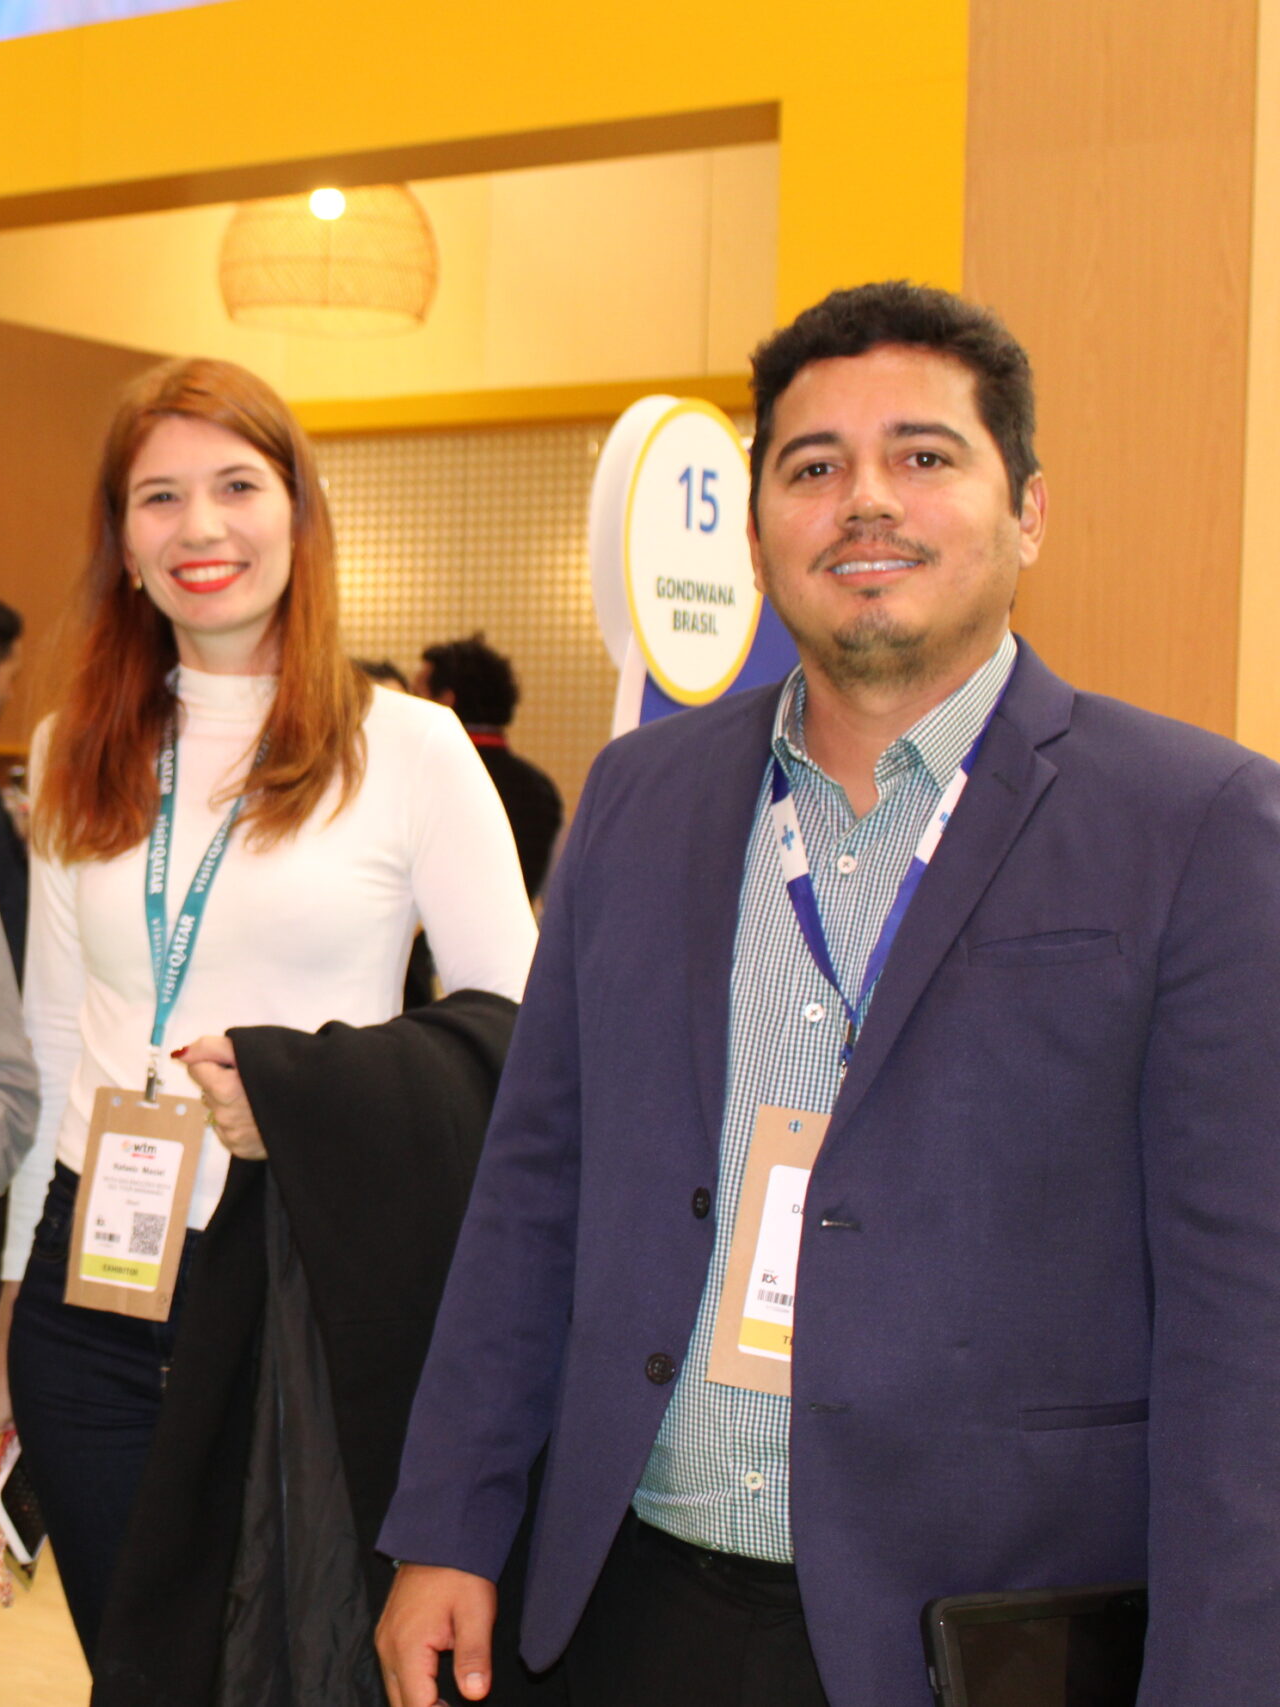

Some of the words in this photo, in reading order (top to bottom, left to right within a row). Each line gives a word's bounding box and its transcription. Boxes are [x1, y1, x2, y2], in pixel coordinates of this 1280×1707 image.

[677, 464, 720, 534] 15
[656, 576, 736, 606] GONDWANA
[672, 609, 718, 636] BRASIL
[149, 814, 169, 895] visitQATAR
[162, 914, 195, 1004] visitQATAR
[134, 1142, 157, 1155] wtm
